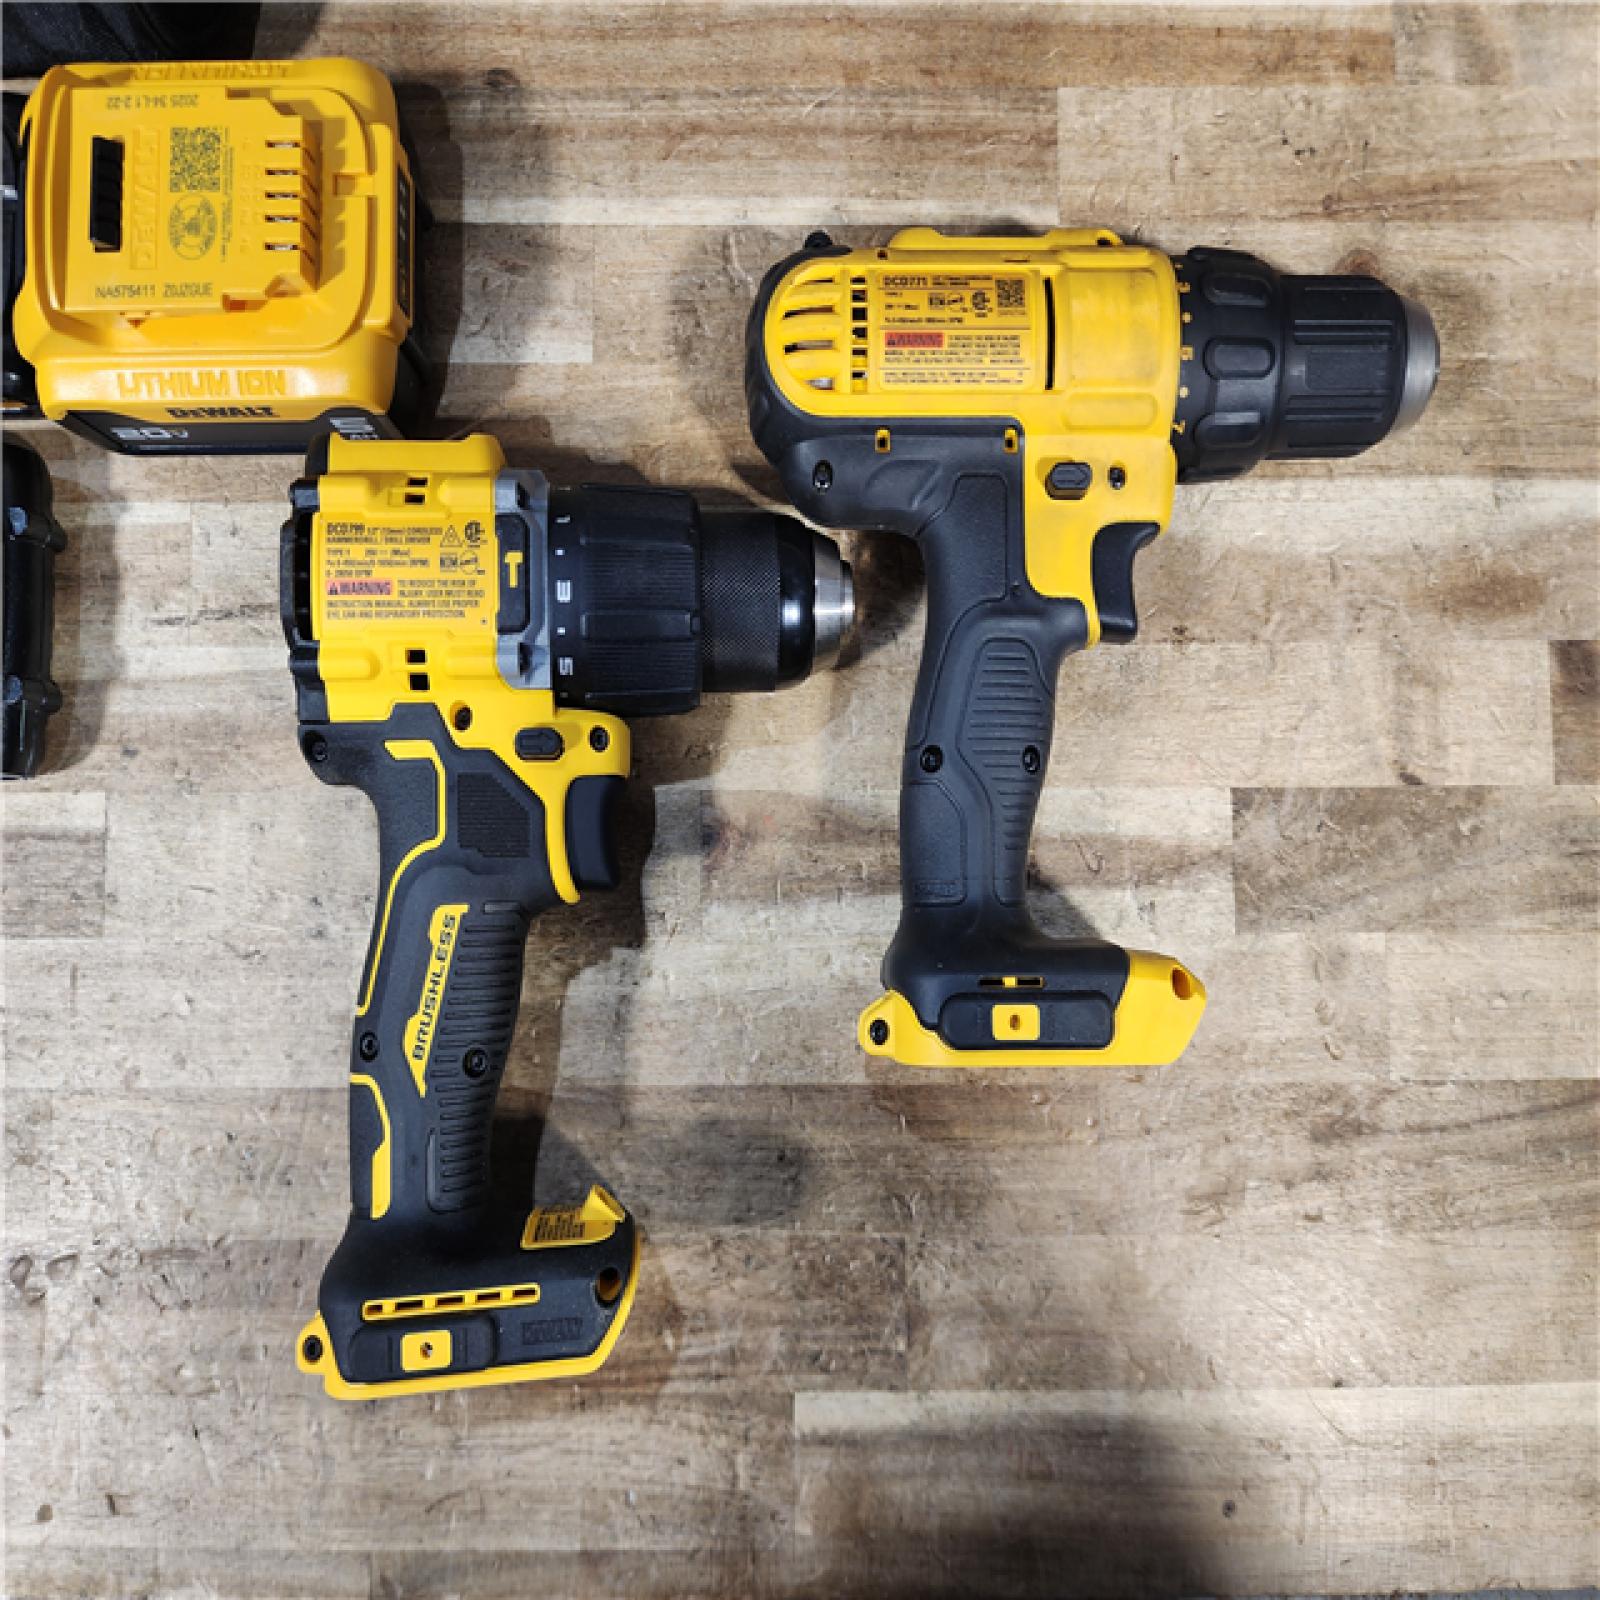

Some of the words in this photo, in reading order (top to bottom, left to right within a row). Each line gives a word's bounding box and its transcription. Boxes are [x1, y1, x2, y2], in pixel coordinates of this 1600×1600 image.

[116, 372, 230, 397] LITHIUM
[237, 371, 286, 396] ION
[339, 581, 392, 595] WARNING
[413, 914, 456, 1061] BRUSHLESS
